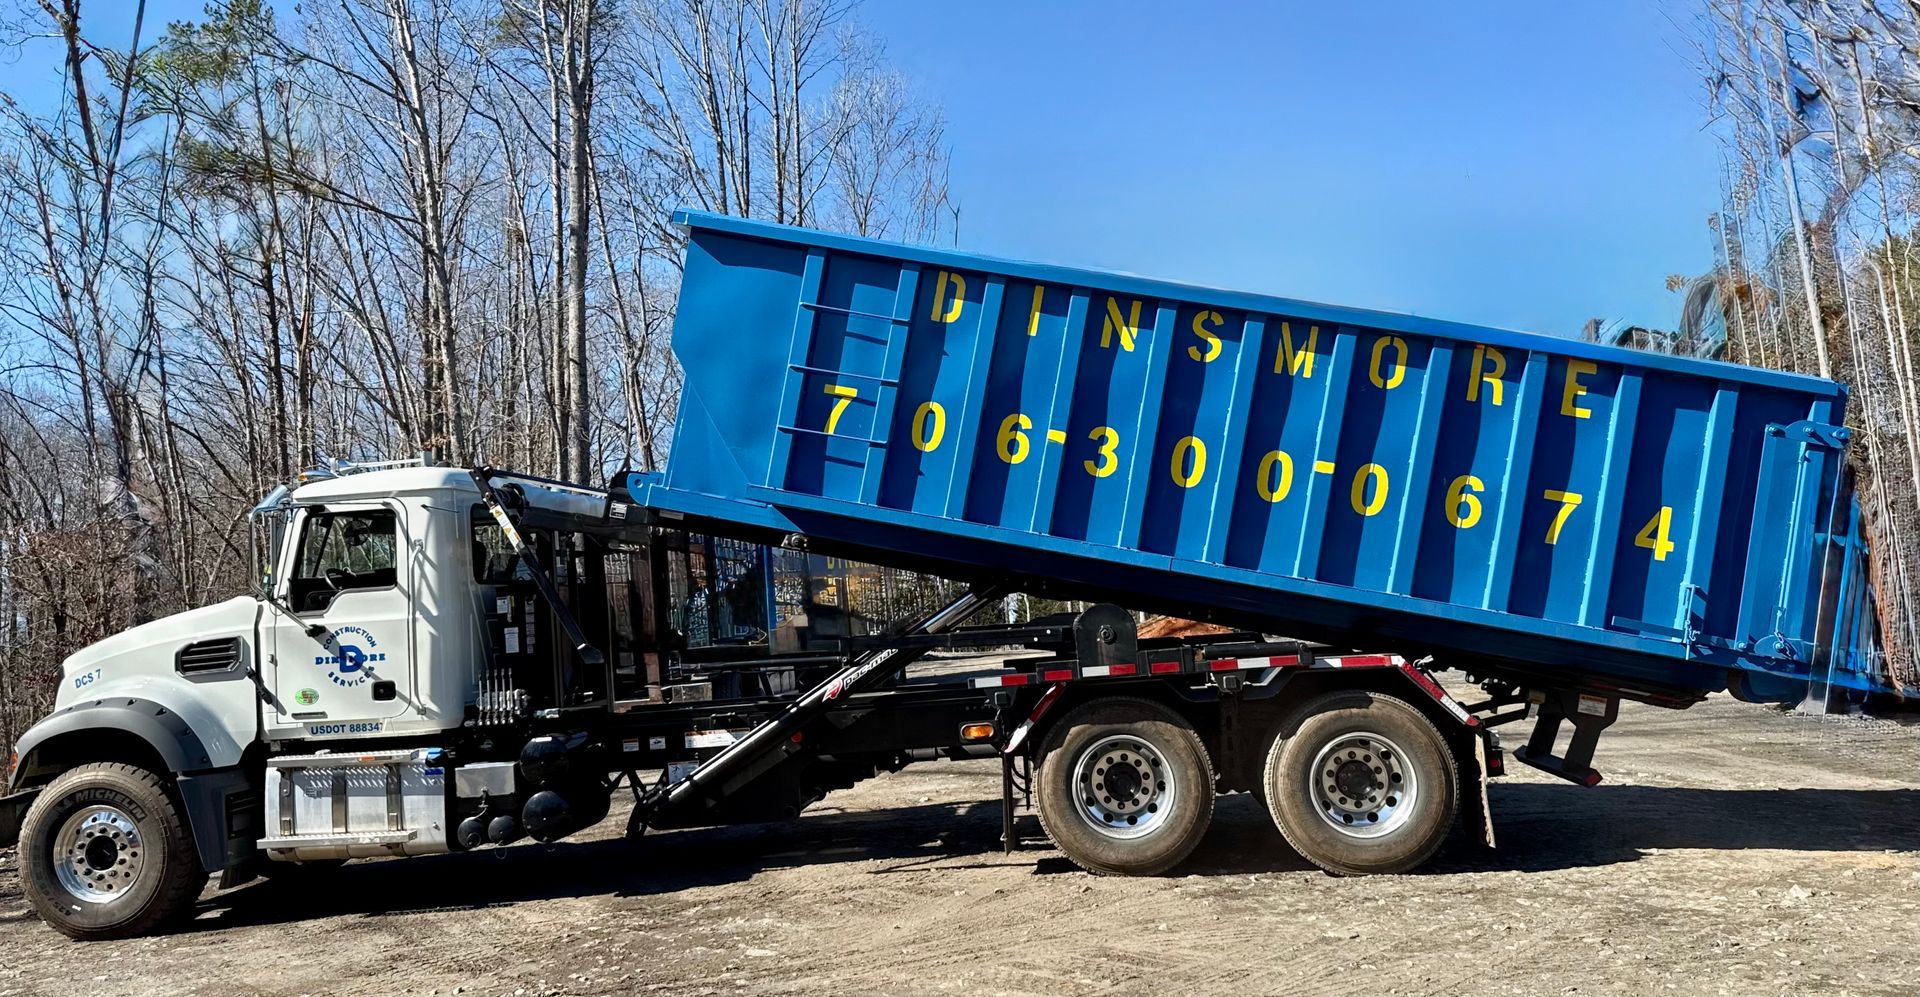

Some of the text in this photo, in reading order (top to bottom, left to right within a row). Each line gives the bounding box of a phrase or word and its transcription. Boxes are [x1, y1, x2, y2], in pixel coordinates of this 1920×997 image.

[323, 626, 377, 650] CONSTRUCTION
[315, 653, 386, 665] DINORE
[75, 668, 101, 688] DCS 7
[328, 666, 375, 687] SERVICES
[311, 725, 346, 735] USDOT
[75, 788, 146, 821] MICHELIN
